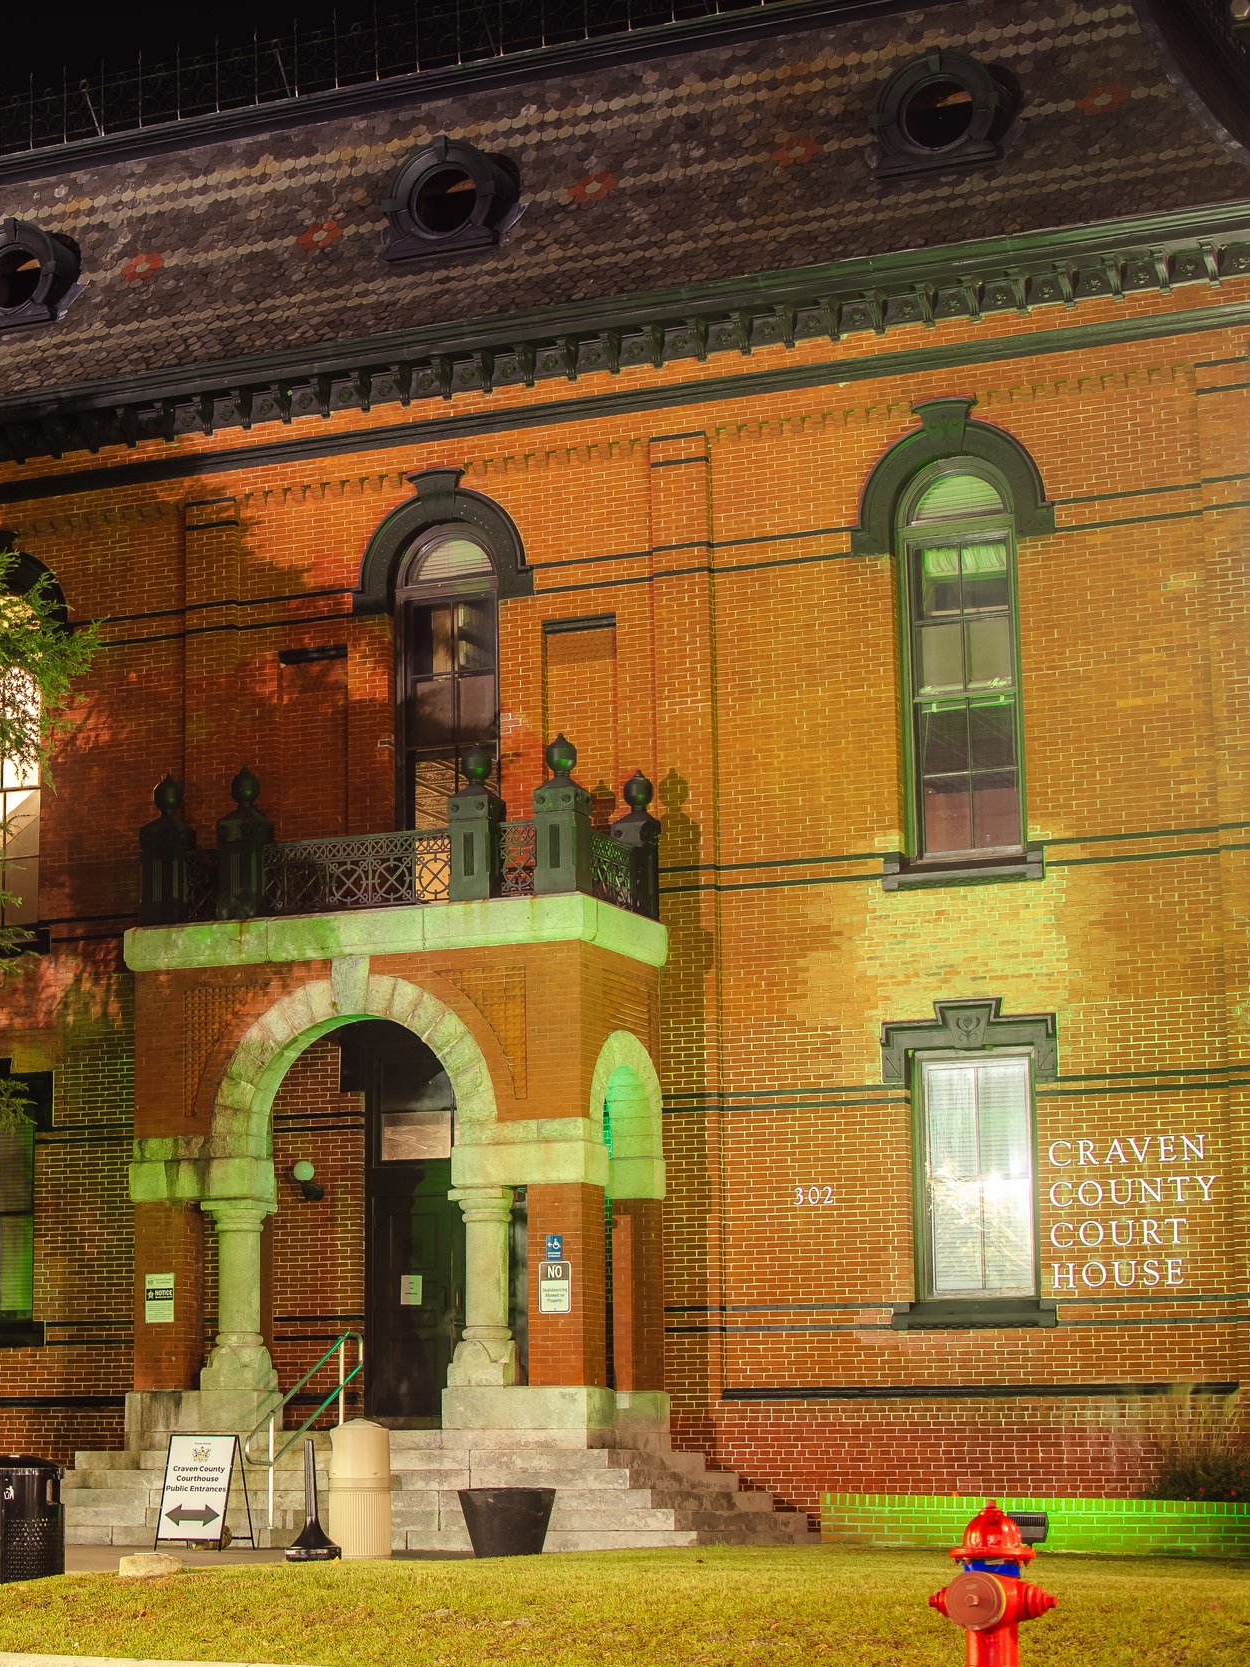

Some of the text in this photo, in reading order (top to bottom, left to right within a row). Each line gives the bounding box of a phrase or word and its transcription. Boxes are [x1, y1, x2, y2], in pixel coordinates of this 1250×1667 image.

[1048, 1134, 1206, 1167] CRAVEN
[793, 1186, 834, 1205] 302
[1049, 1175, 1217, 1207] COUNTY
[1050, 1218, 1187, 1248] COURT
[547, 1265, 562, 1278] NO
[1051, 1259, 1185, 1289] HOUSE
[199, 1465, 225, 1473] County
[165, 1484, 227, 1493] Public Entrances
